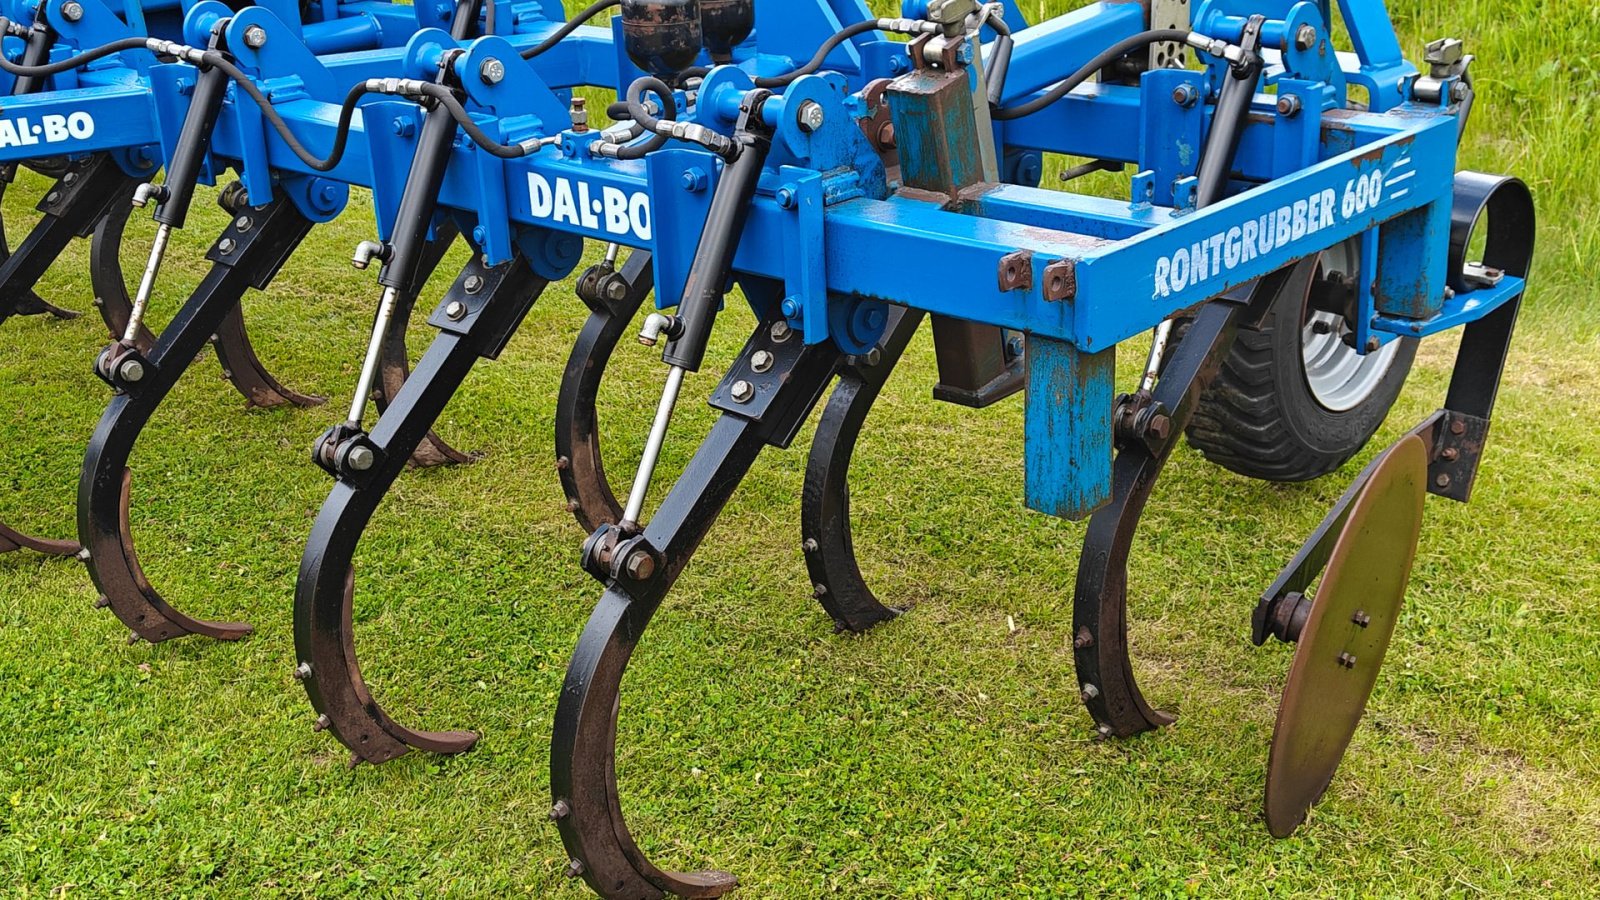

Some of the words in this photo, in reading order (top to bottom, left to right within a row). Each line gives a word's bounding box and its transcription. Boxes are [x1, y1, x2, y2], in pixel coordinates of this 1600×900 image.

[0, 111, 95, 149] AL·BO
[1152, 188, 1336, 299] RONTGRUBBER
[1341, 168, 1382, 220] 600
